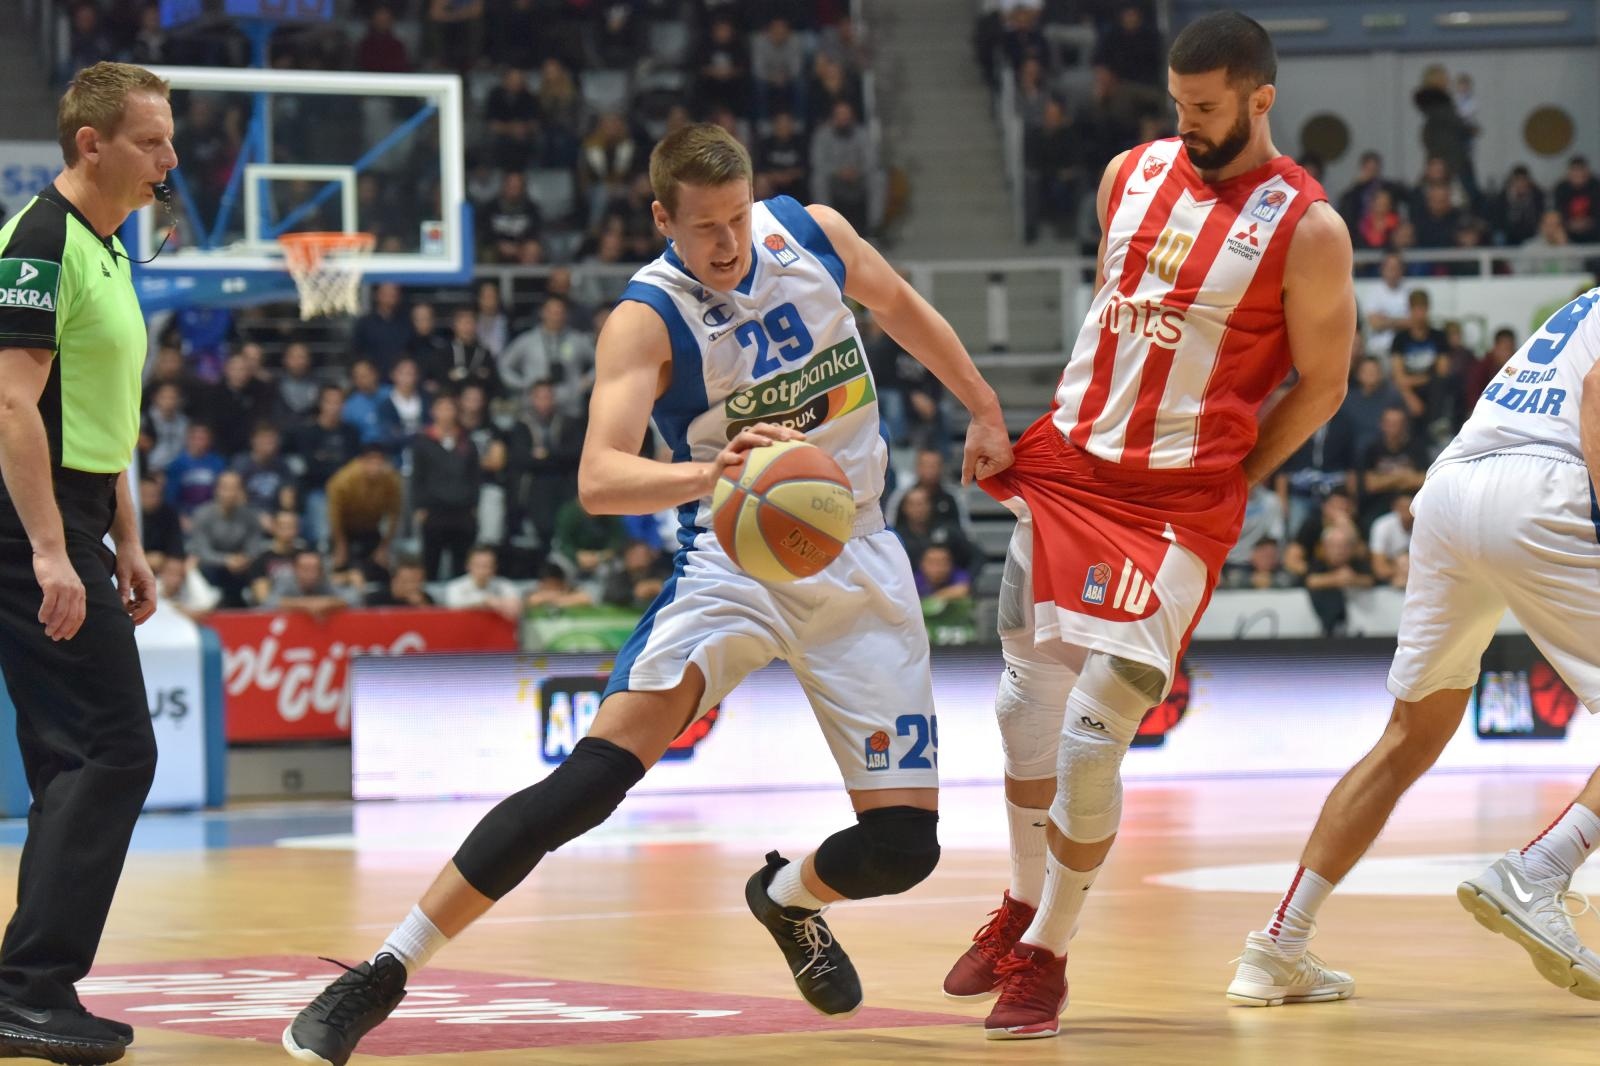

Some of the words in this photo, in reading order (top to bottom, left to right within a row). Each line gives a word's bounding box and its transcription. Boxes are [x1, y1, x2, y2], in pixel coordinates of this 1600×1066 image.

[1252, 204, 1275, 220] ABA
[776, 249, 798, 265] ABA
[1146, 228, 1193, 284] 10
[1227, 238, 1261, 257] MITSUBISHI
[1228, 246, 1253, 261] MOTORS
[0, 288, 53, 309] DEKRA
[1099, 295, 1185, 343] mts
[735, 302, 814, 380] 29
[1516, 367, 1557, 384] GRAD
[1481, 382, 1567, 416] ADAR
[1085, 584, 1103, 601] ABA
[545, 691, 601, 756] AB
[868, 753, 888, 769] ABA
